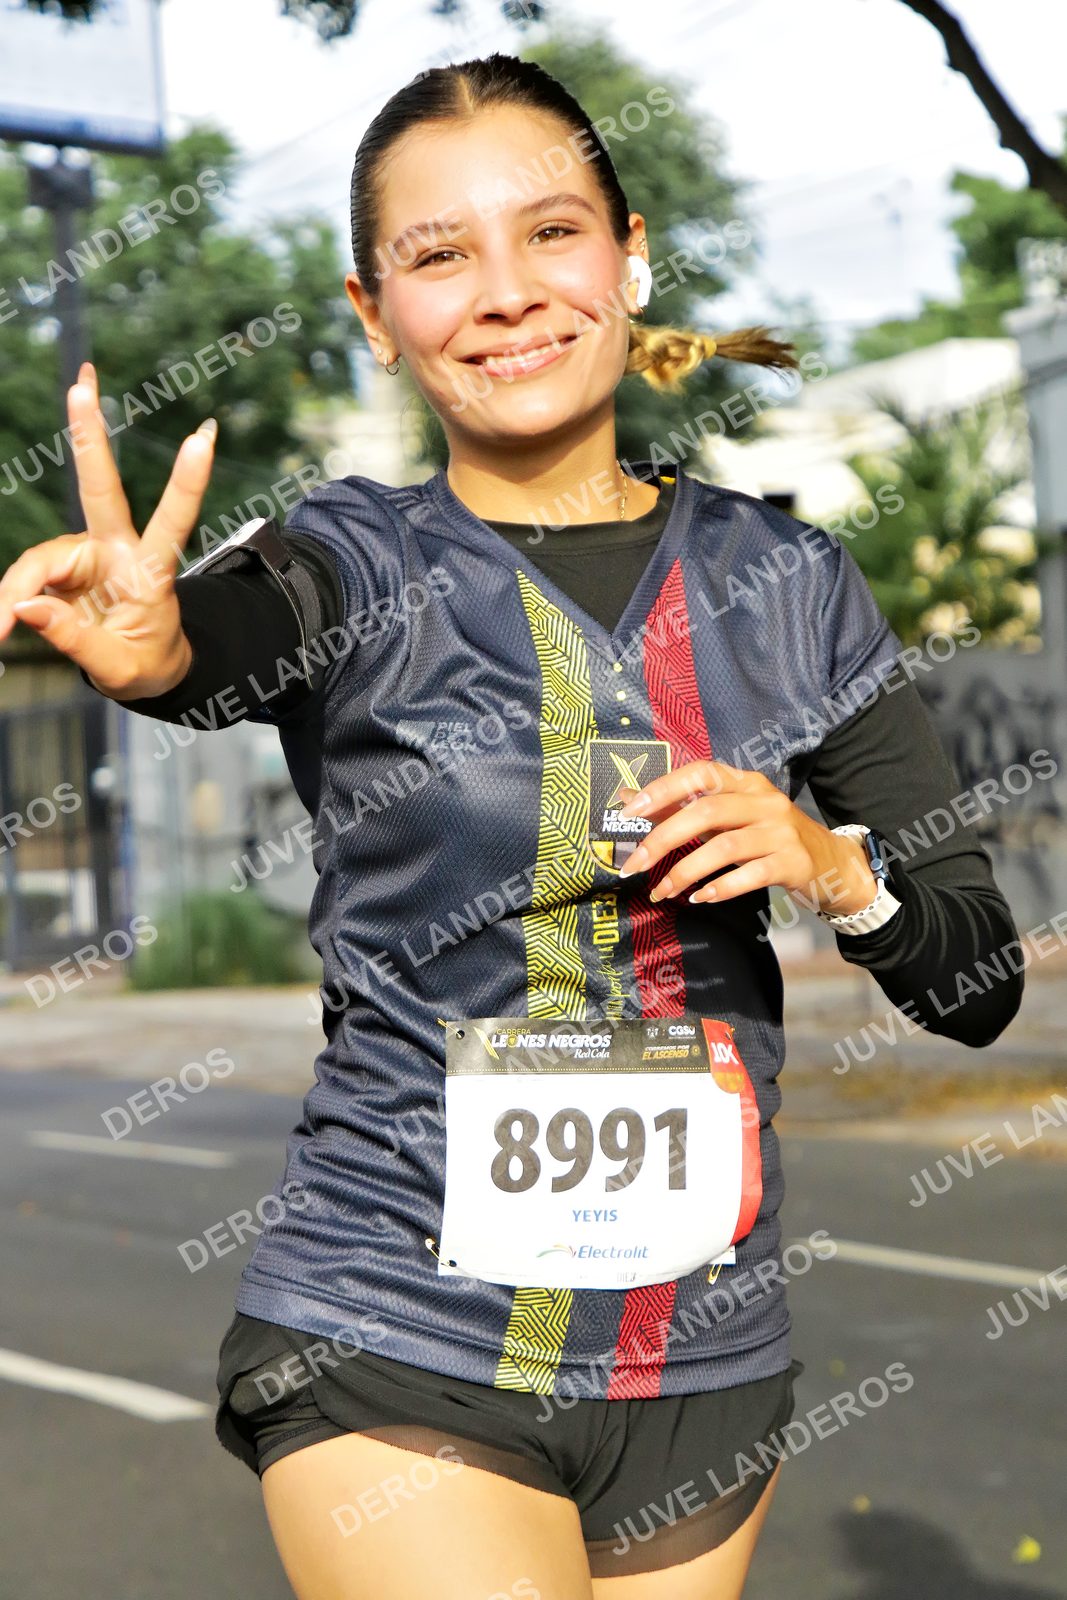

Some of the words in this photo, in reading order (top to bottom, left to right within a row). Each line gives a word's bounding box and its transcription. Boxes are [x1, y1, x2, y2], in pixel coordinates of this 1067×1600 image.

[602, 821, 653, 833] NEGROS
[598, 946, 614, 960] LA
[549, 1034, 613, 1049] NEGROS
[642, 1051, 654, 1060] EL
[652, 1049, 690, 1060] ASCENSO
[711, 1041, 739, 1065] 10K
[491, 1107, 687, 1193] 8991
[572, 1209, 618, 1222] YEYIS
